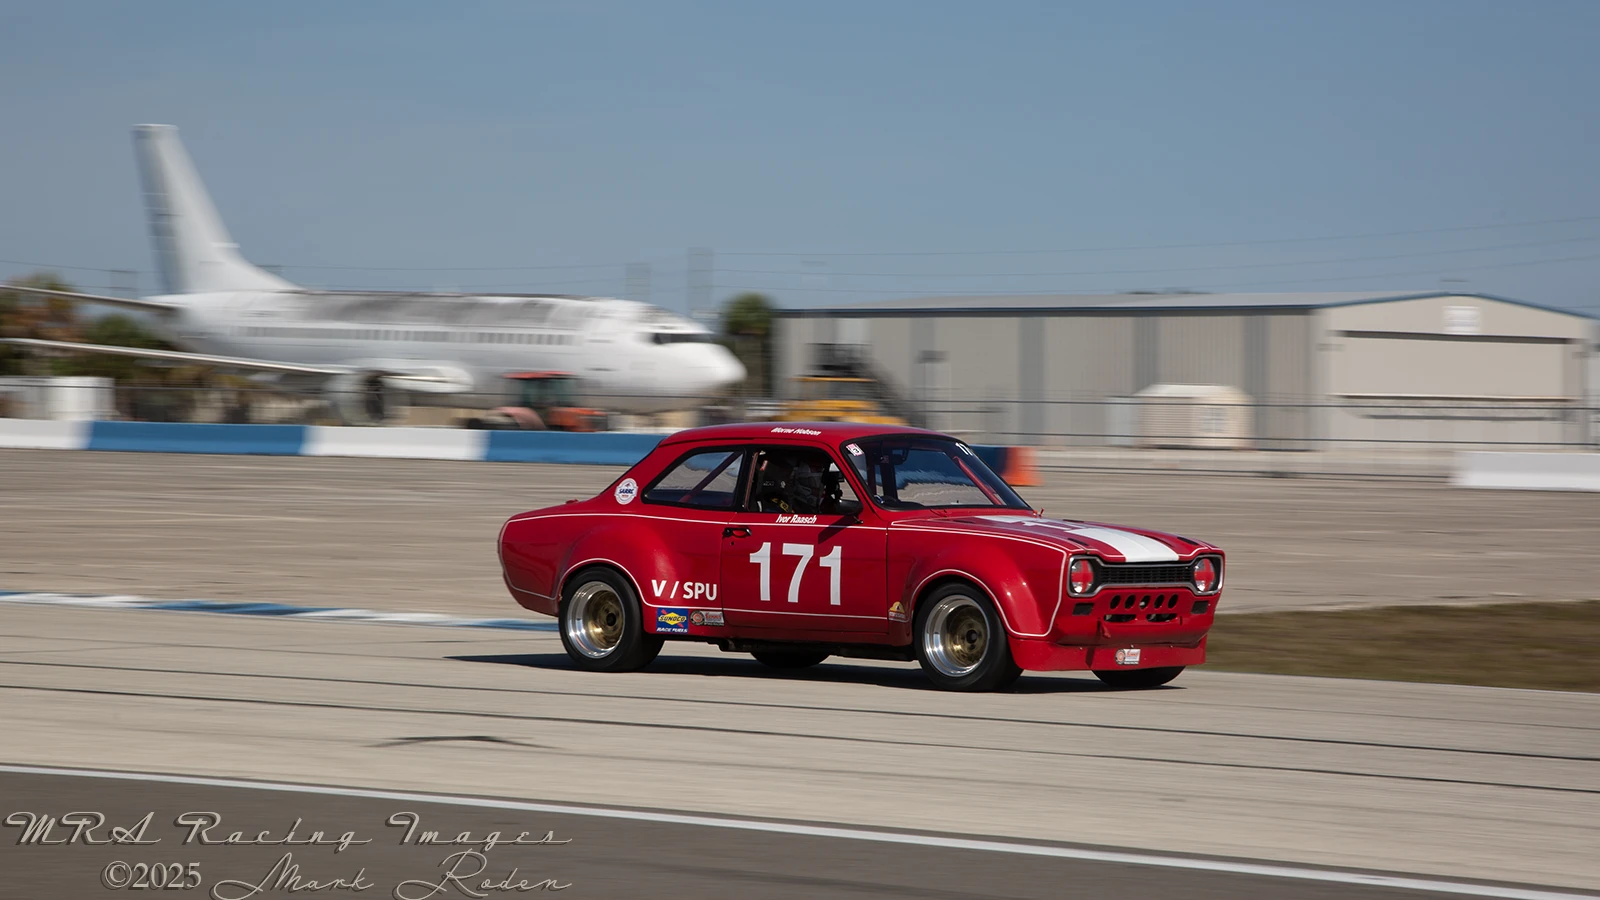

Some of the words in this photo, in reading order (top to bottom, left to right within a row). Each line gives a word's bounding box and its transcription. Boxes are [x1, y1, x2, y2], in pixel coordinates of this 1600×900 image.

[776, 514, 792, 523] Ivor
[789, 514, 818, 524] Raasch
[749, 542, 842, 606] 171
[651, 579, 667, 597] V
[669, 580, 680, 599] /
[682, 581, 717, 601] SPU
